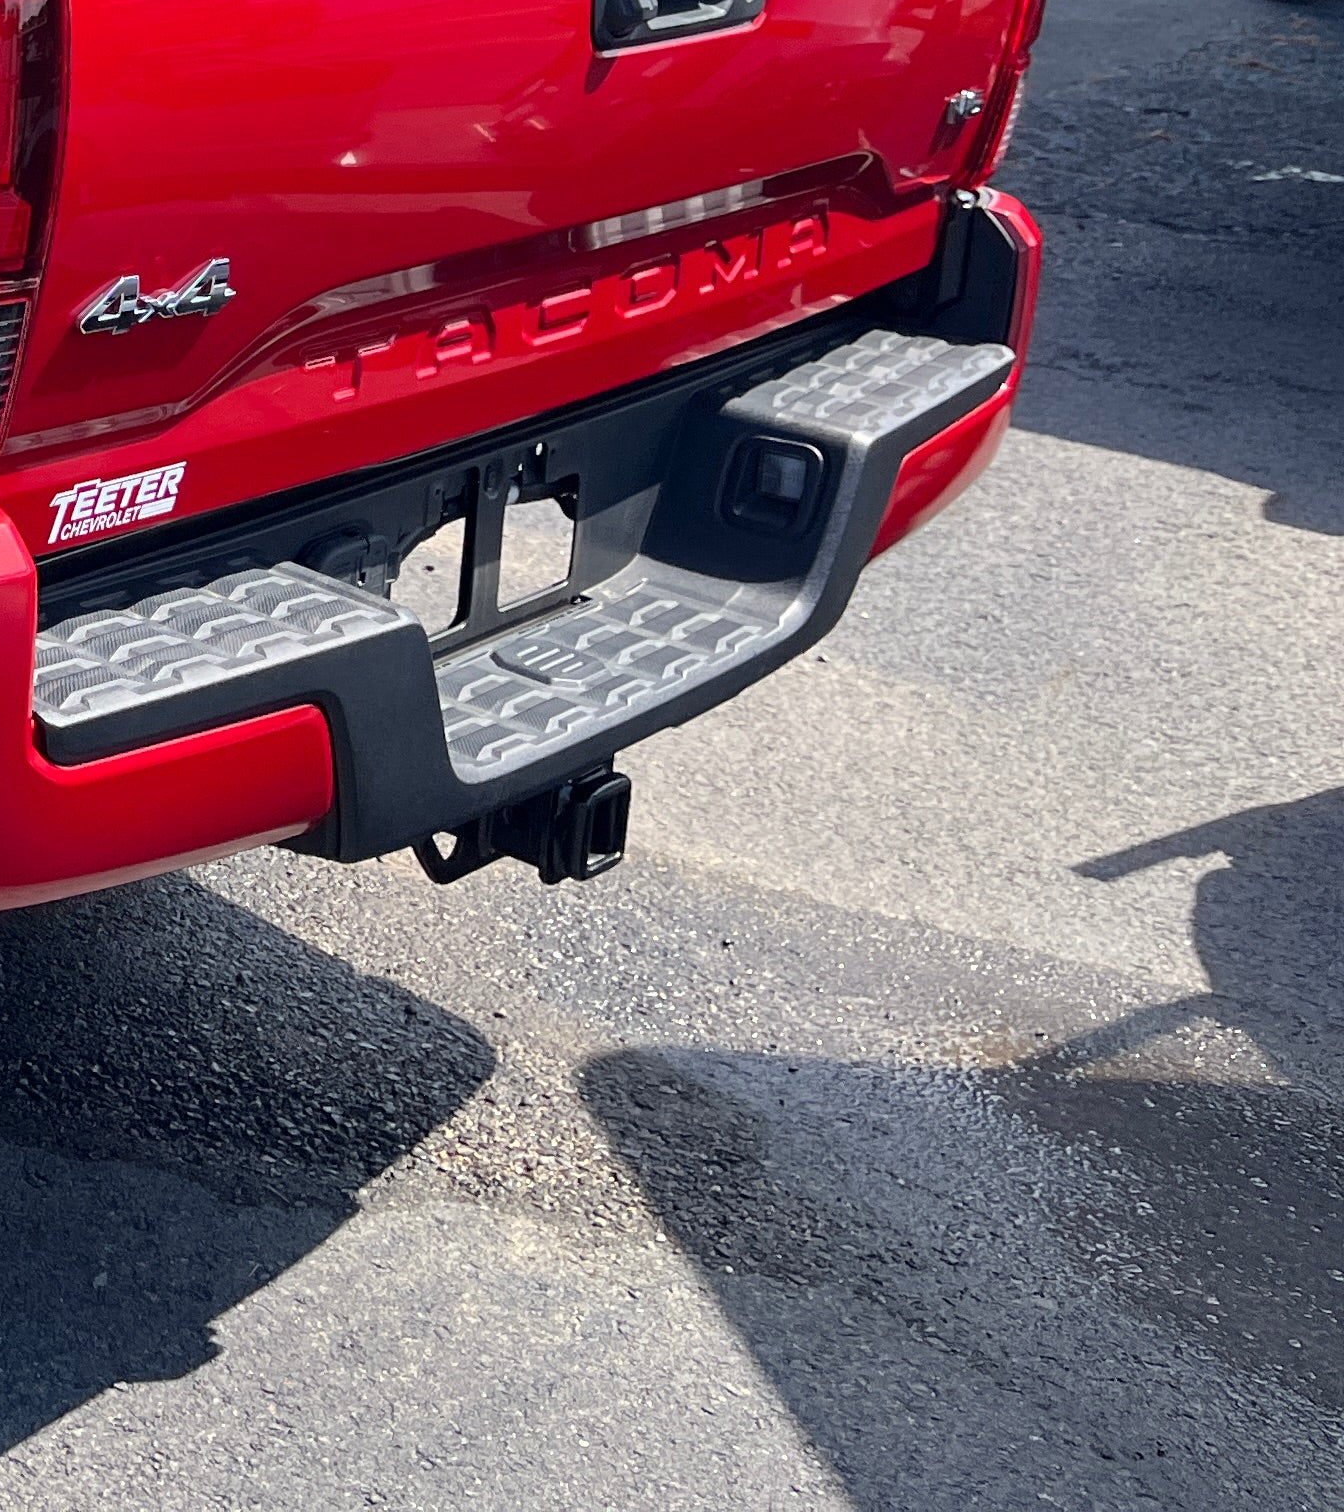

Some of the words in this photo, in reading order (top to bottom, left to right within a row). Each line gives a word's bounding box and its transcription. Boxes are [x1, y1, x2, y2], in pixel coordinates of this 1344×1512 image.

[303, 209, 831, 401] TACOMA
[47, 461, 188, 545] TEETER
[60, 504, 142, 541] CHEVROLET
